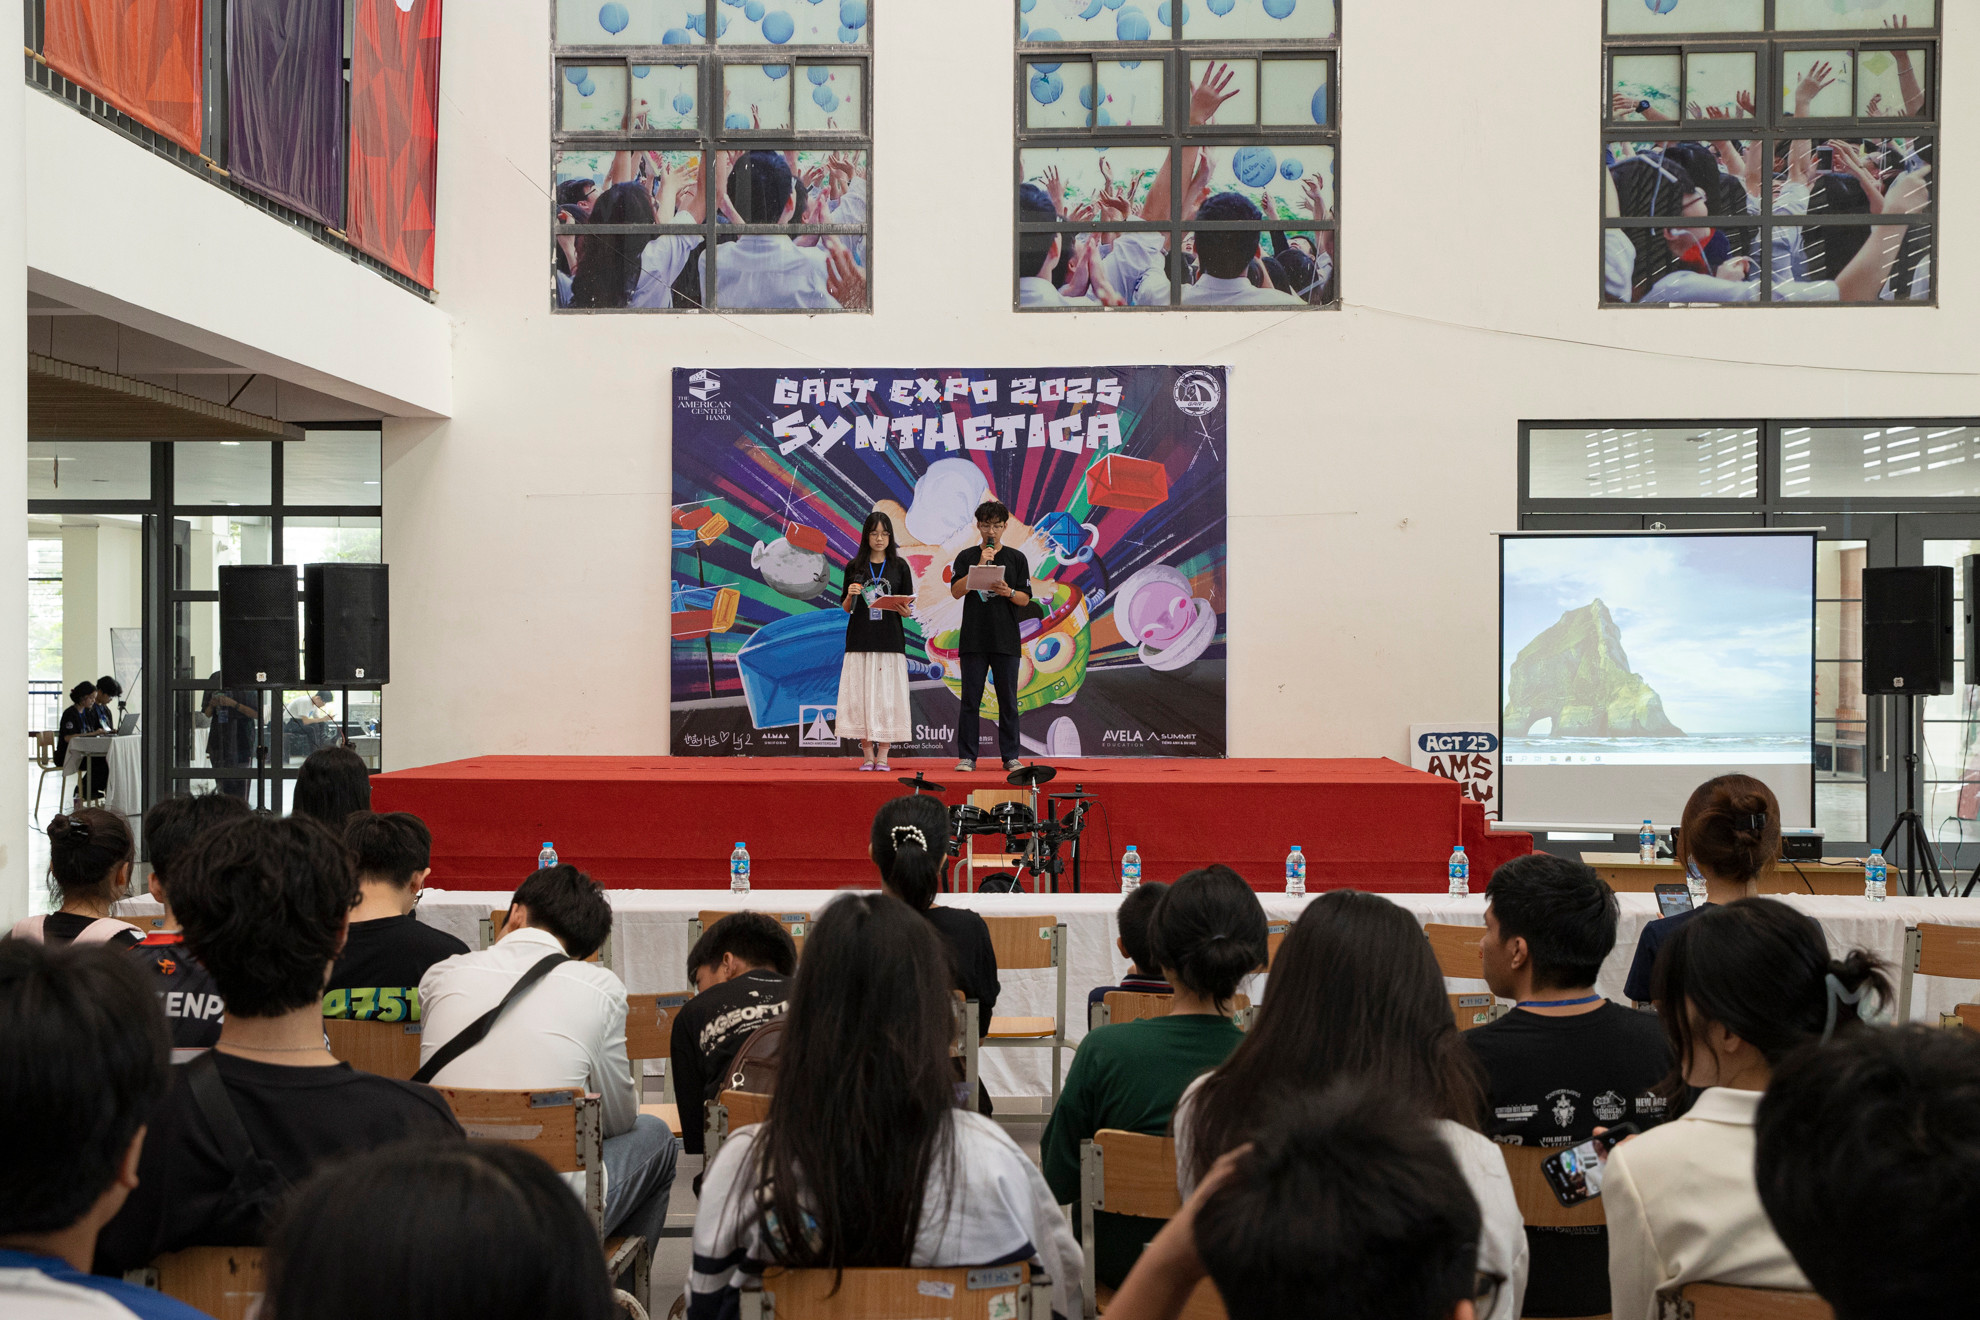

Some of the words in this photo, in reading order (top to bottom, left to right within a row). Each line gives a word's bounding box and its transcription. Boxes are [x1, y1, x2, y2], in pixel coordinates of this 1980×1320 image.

[773, 378, 878, 408] GART
[891, 377, 997, 406] EXPO
[1011, 377, 1123, 407] 2025
[772, 409, 1123, 456] SYNTHETICA
[916, 724, 955, 743] Study
[1102, 730, 1143, 741] AVELA
[1466, 735, 1490, 751] 25
[921, 742, 944, 750] Schools
[1427, 752, 1494, 783] AMS
